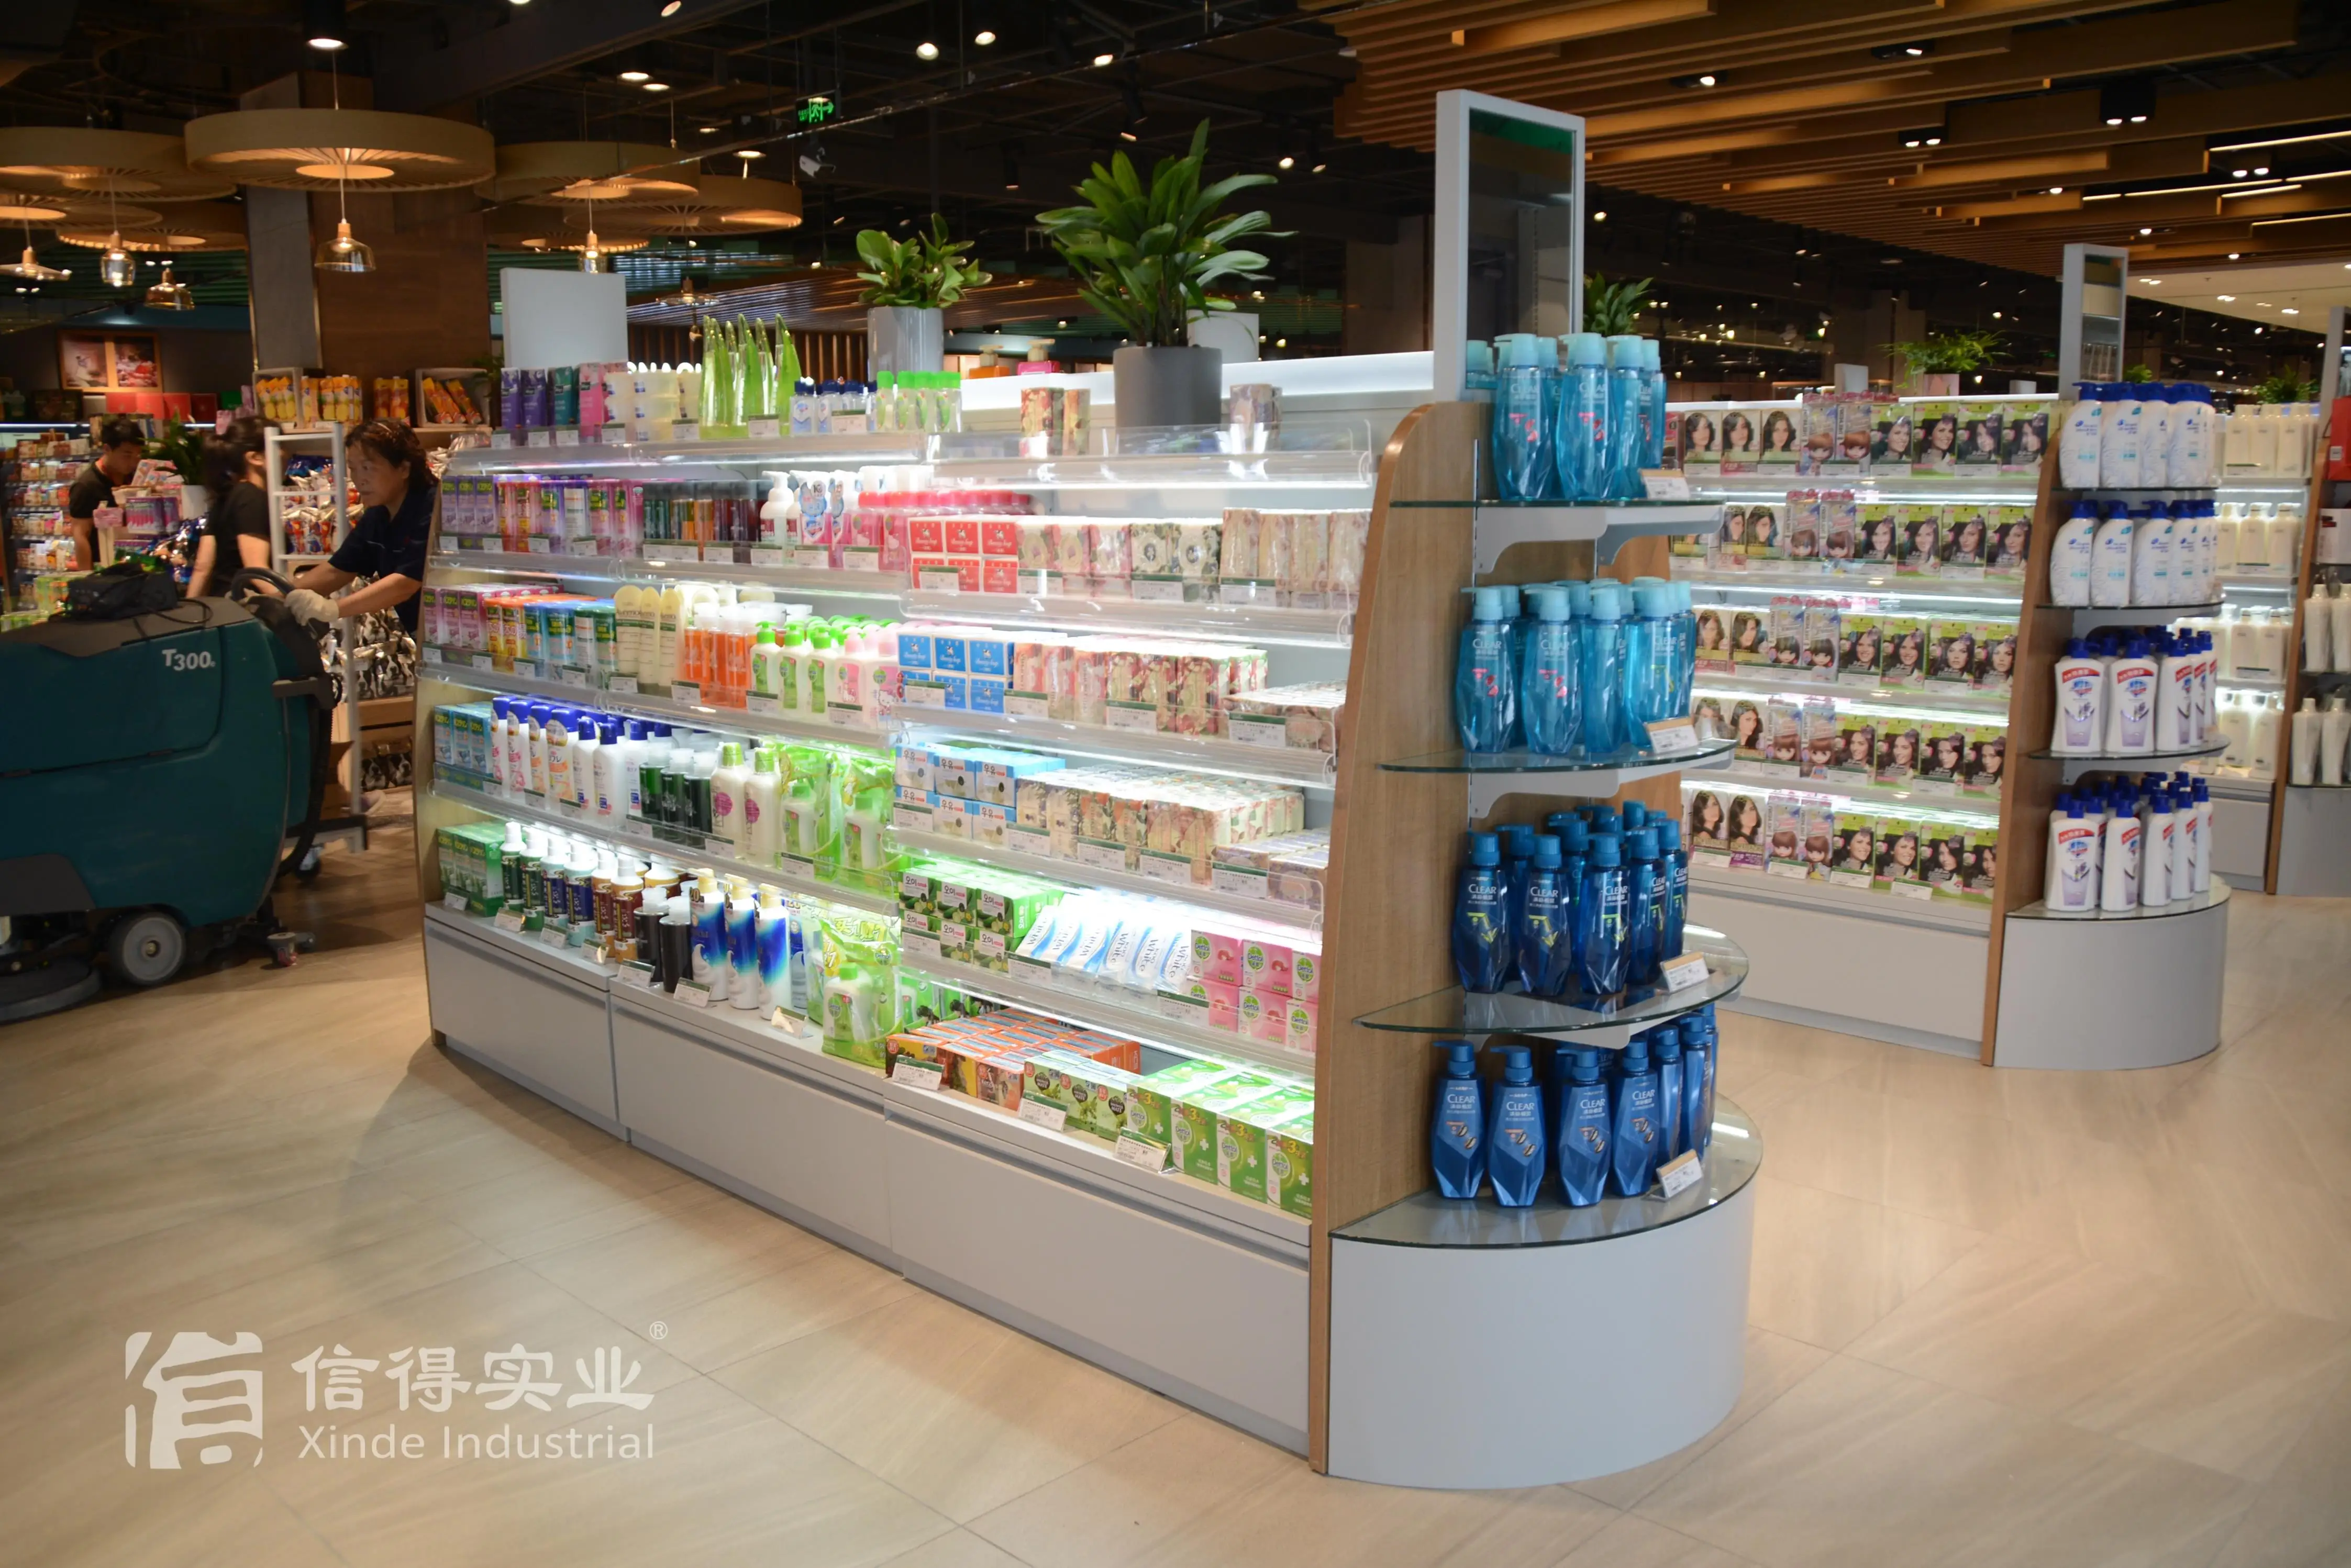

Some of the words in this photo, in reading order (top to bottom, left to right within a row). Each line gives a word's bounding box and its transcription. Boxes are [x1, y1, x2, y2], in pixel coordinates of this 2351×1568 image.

[1472, 638, 1502, 650] CLEAR
[1469, 884, 1497, 895] CLEAR
[1531, 886, 1559, 897] CLEAR
[1111, 933, 1128, 962] White
[1139, 939, 1159, 972] White
[1248, 953, 1263, 962] Dettol
[1169, 946, 1190, 977] White
[1297, 964, 1313, 973] Dettol
[1447, 1094, 1476, 1104] CLEAR
[1632, 1089, 1656, 1099] CLEAR
[1506, 1101, 1535, 1111] CLEAR
[1580, 1098, 1606, 1109] CLEAR
[1222, 1142, 1237, 1152] Dettol
[1272, 1158, 1288, 1170] Dettol
